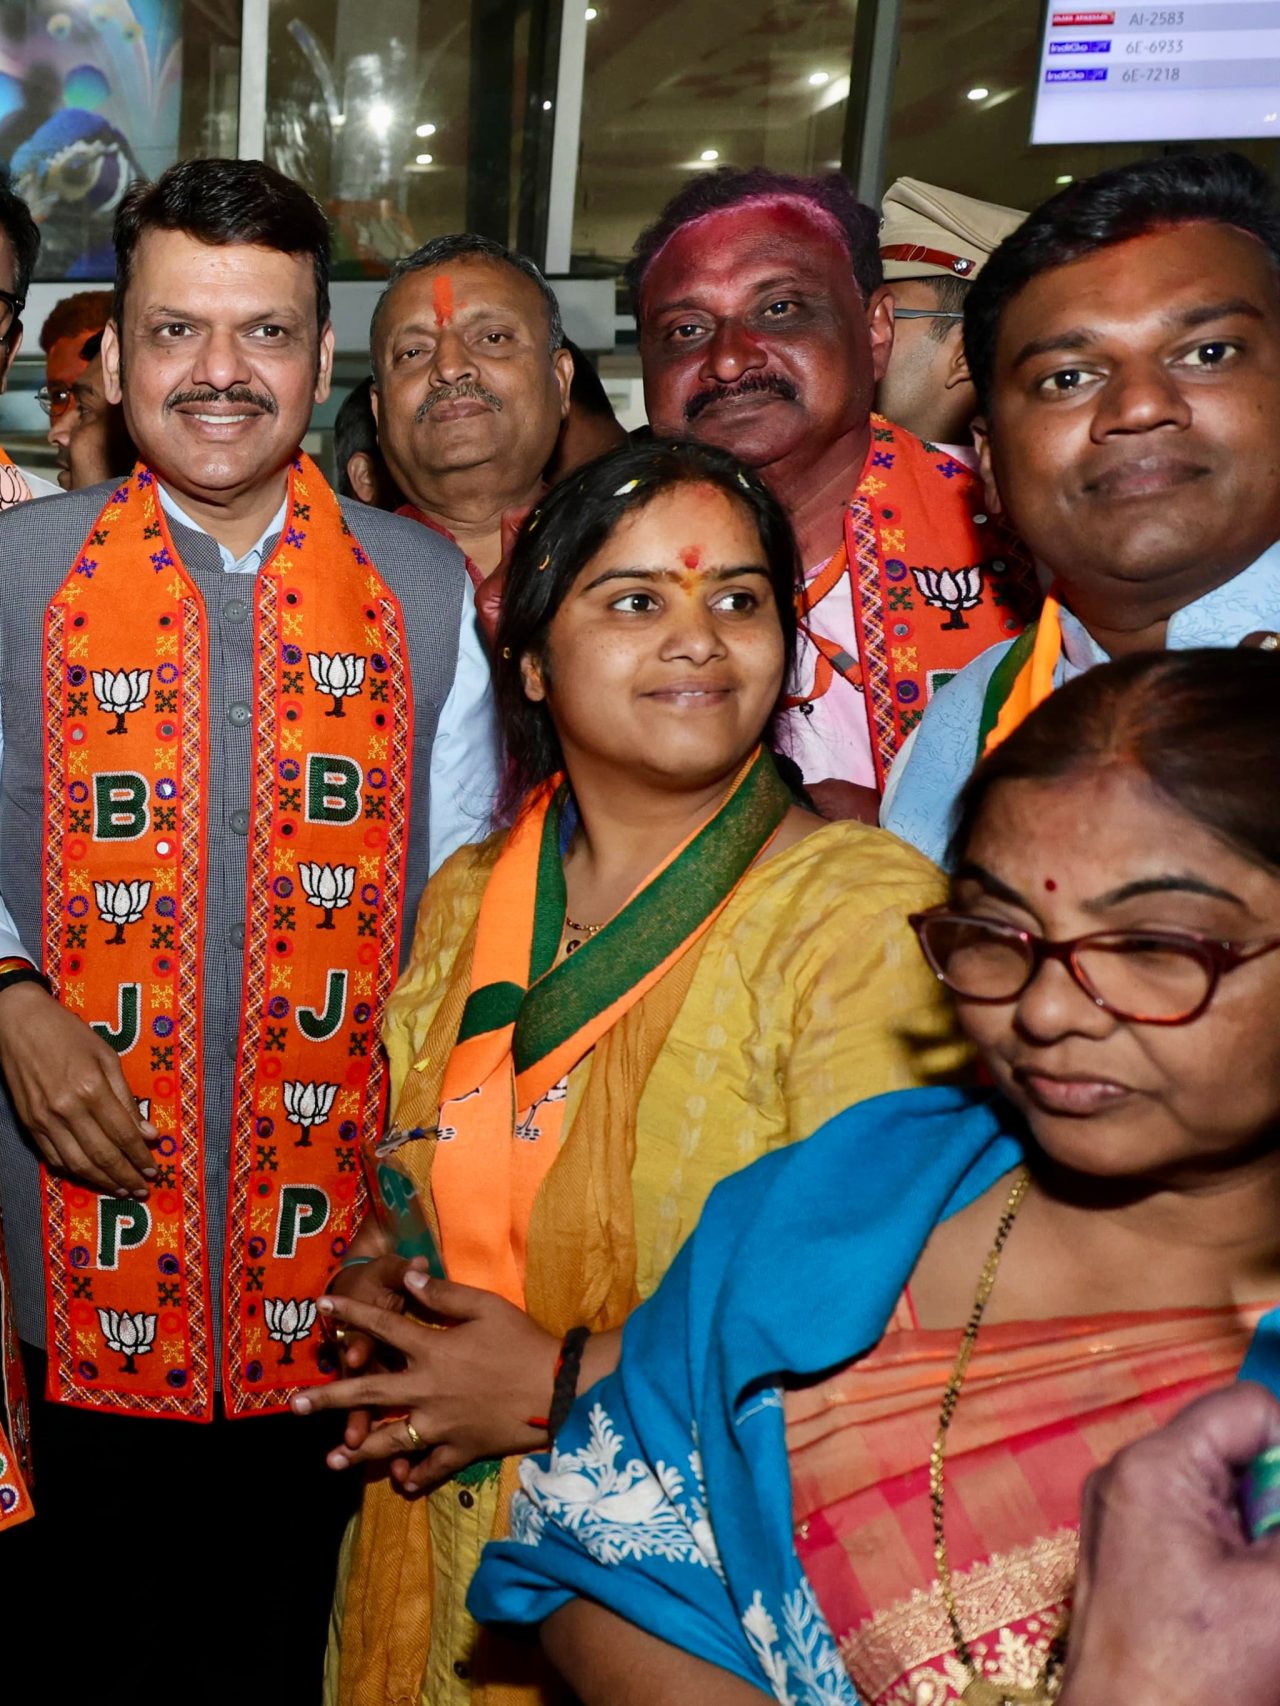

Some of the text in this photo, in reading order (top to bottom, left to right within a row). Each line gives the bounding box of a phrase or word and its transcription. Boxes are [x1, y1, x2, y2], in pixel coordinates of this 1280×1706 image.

[1129, 11, 1184, 26] AI-2583
[1126, 40, 1183, 54] 6E-6933
[1122, 68, 1180, 82] 6E-7218
[273, 752, 363, 1260] B J P
[90, 770, 153, 1271] B J P
